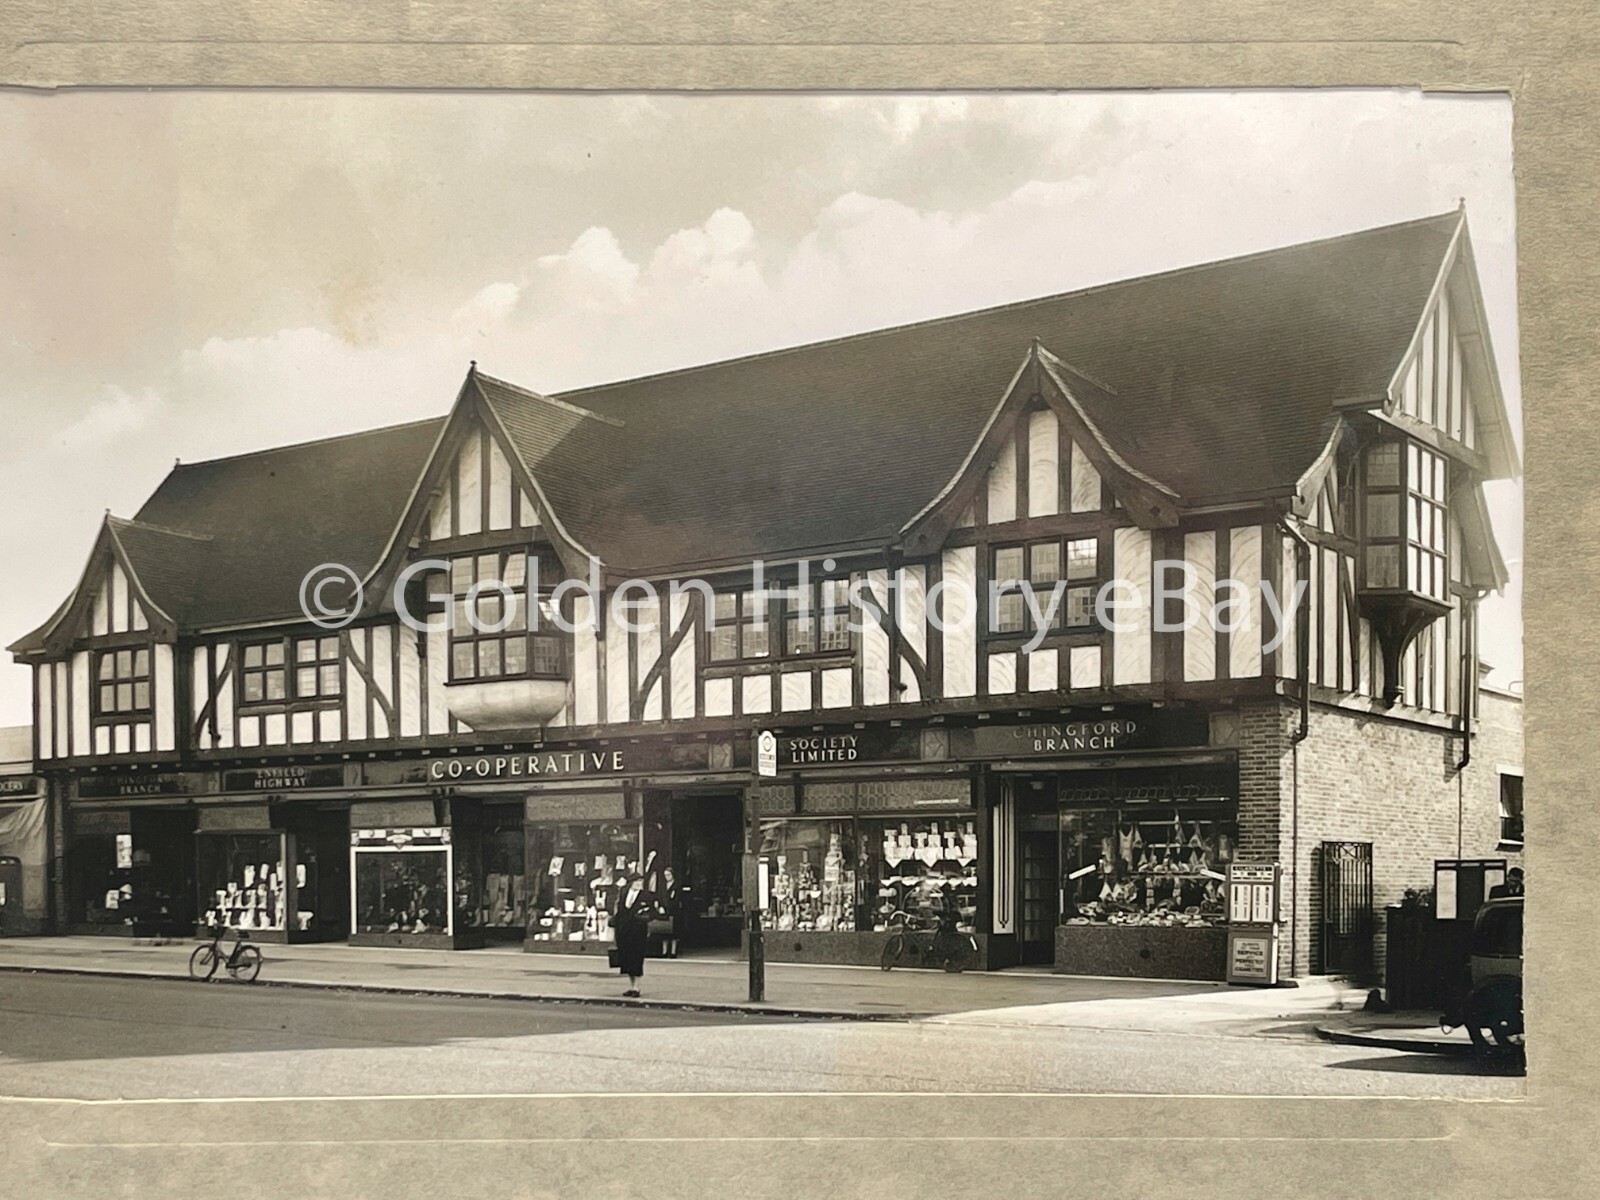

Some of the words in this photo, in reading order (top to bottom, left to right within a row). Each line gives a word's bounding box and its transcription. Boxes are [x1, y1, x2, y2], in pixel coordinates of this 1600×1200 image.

[1013, 720, 1137, 739] CHINGFORD
[790, 736, 858, 751] SOCIETY
[1033, 736, 1115, 751] BRANCH
[792, 748, 857, 763] LIMITED
[256, 767, 305, 778] ENFIELD
[431, 751, 625, 779] CO-OPERATIVE
[119, 785, 161, 795] BRANCH
[254, 777, 307, 789] HIGHWAY
